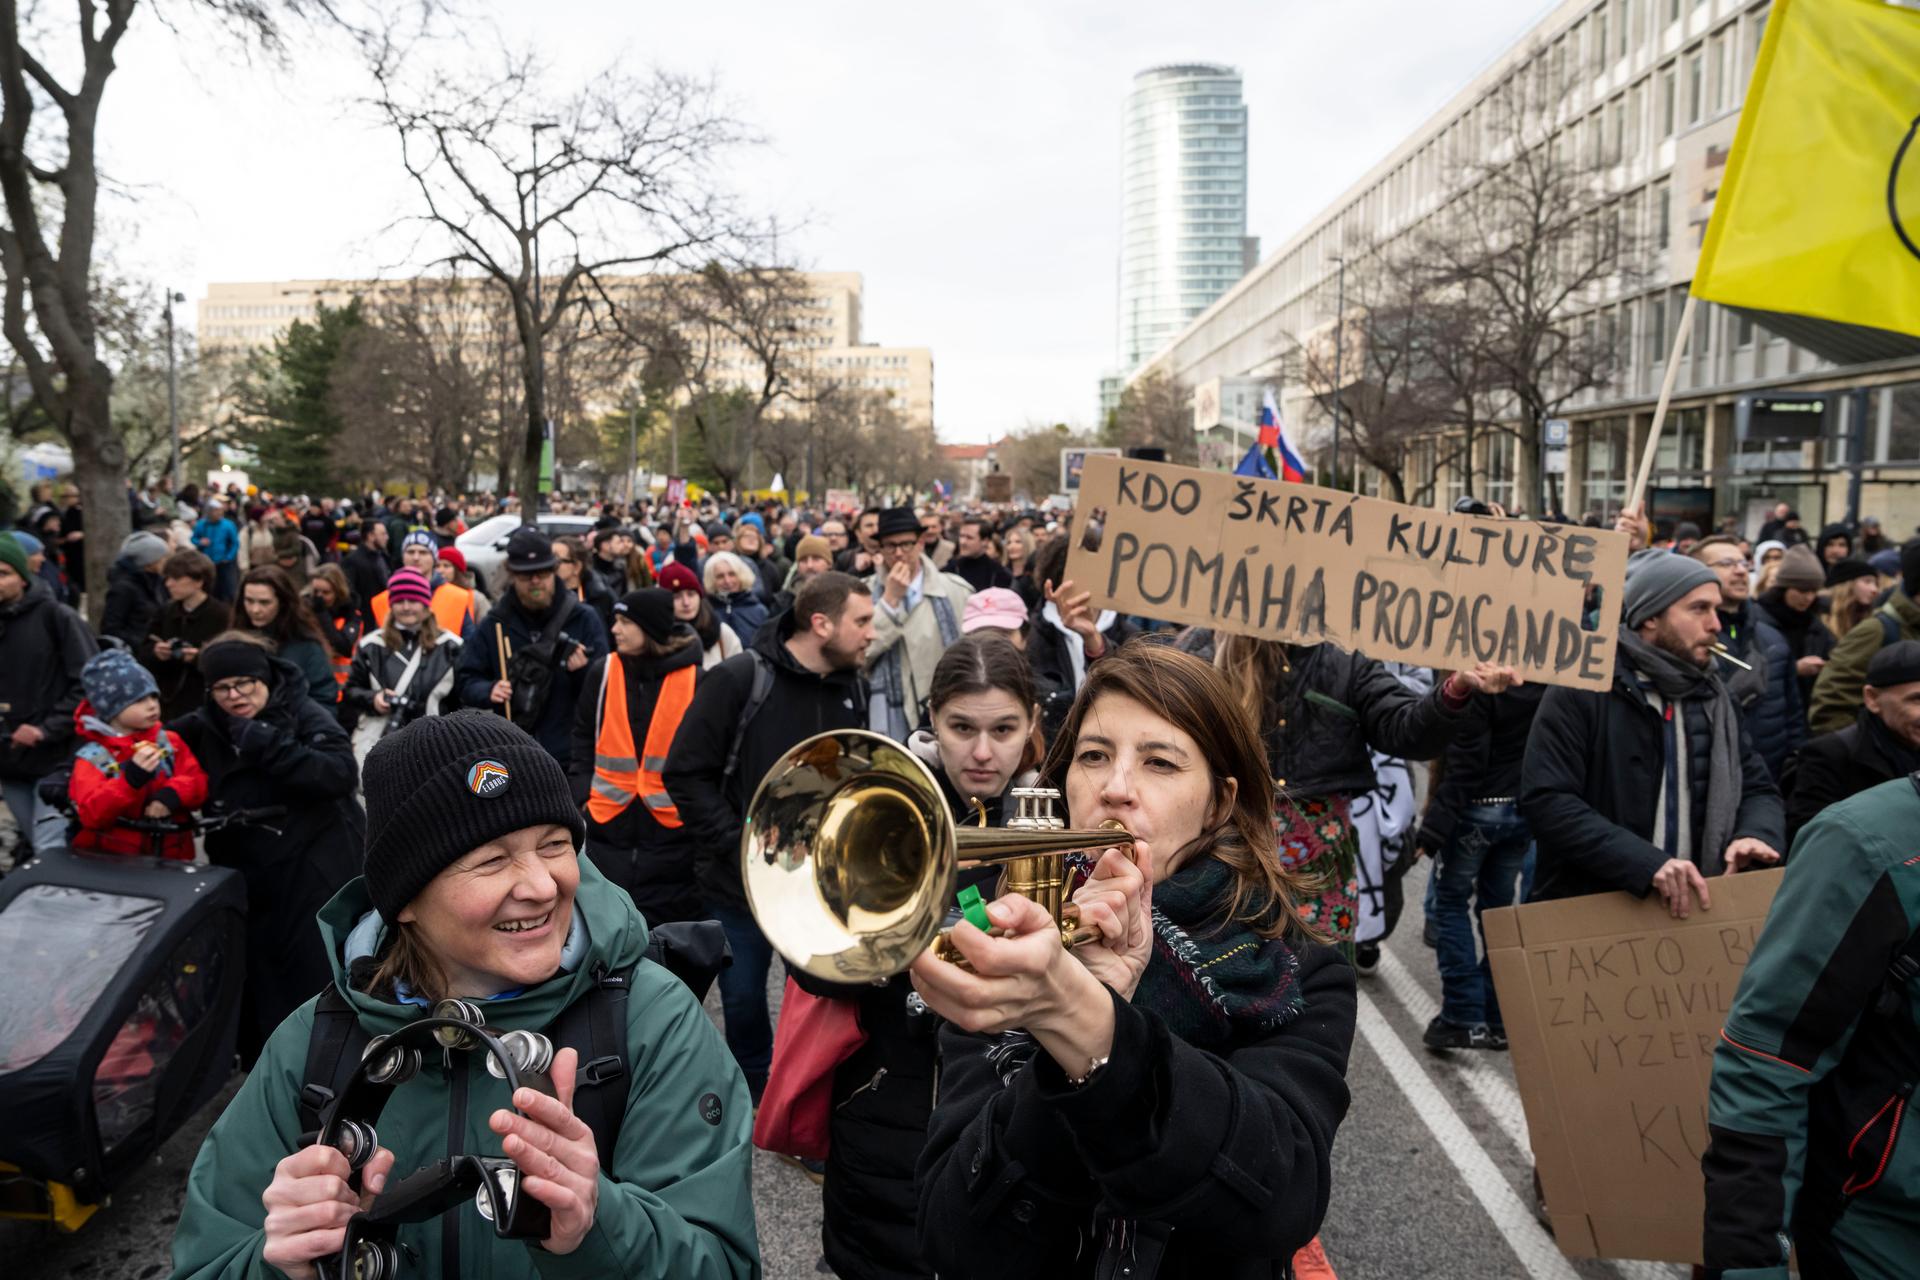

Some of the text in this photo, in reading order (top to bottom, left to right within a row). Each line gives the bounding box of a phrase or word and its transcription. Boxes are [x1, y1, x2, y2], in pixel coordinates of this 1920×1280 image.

[1117, 466, 1598, 587] KDO ŠKRTÁ KULTUŘE
[1107, 532, 1607, 680] POMÁHA PROPAGANDE
[1533, 936, 1685, 986] TAKTO
[1549, 966, 1729, 1026] ZA CHVÍL
[1581, 1031, 1713, 1074] VYZER
[1631, 1100, 1710, 1168] KU
